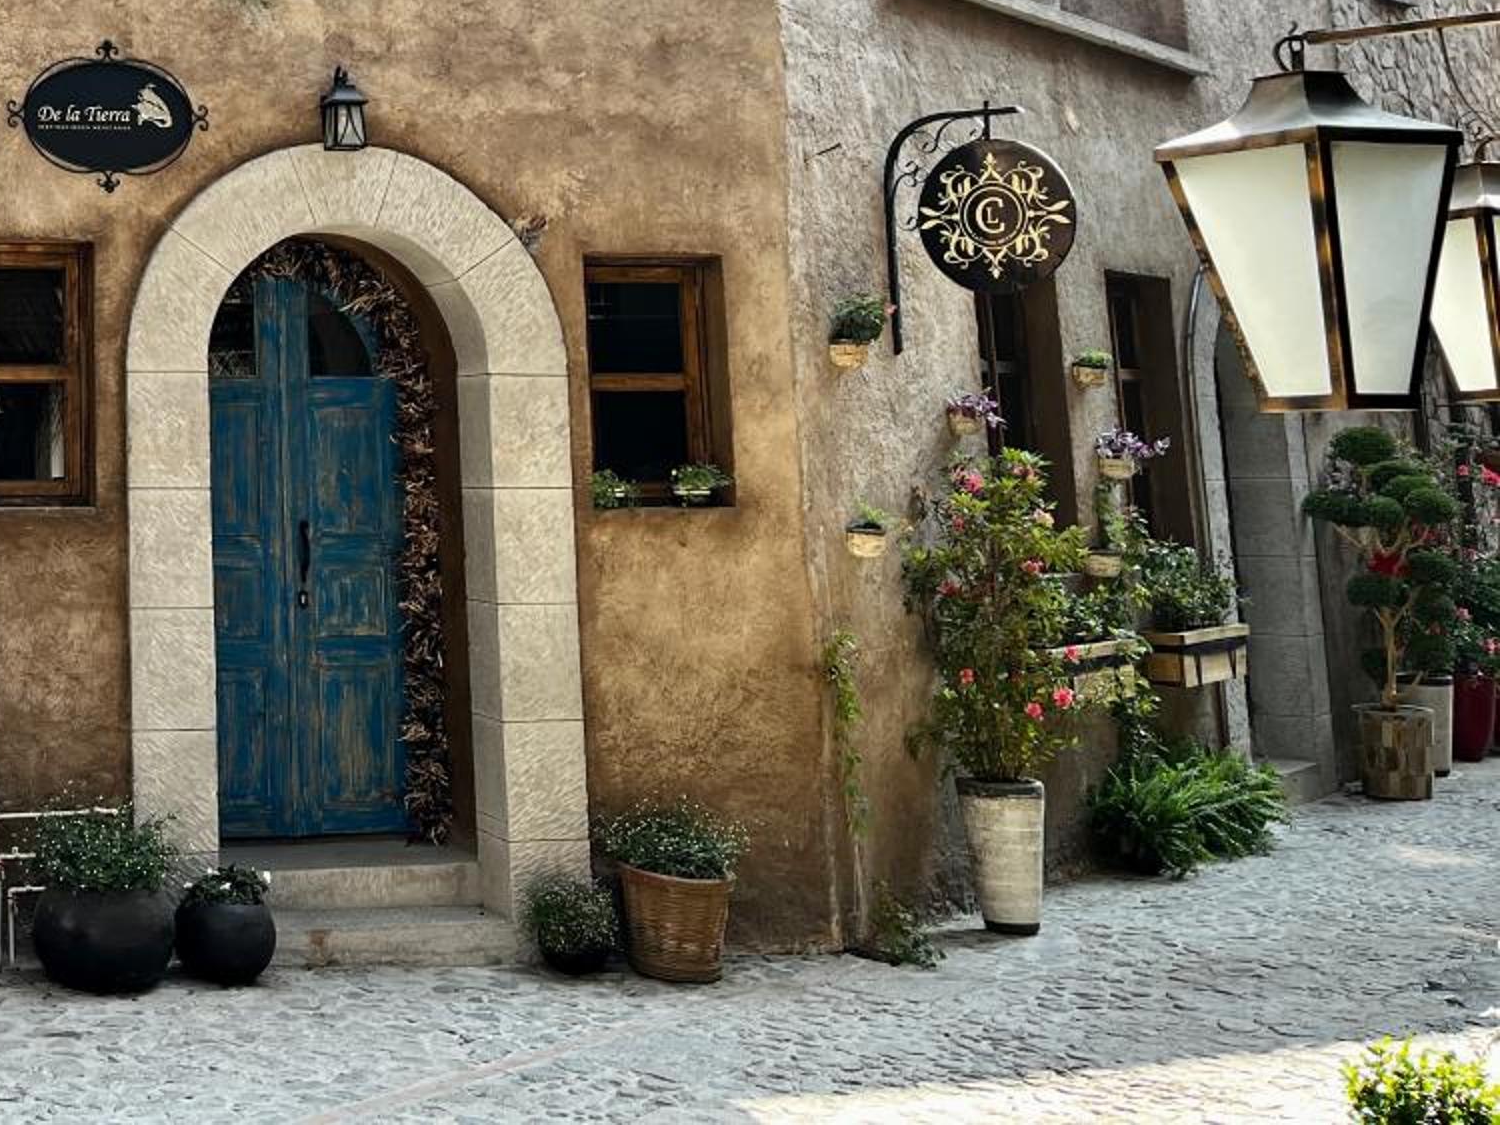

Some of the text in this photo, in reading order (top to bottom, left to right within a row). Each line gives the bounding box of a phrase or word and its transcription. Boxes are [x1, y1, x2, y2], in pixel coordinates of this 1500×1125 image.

[37, 104, 131, 122] De la Tierra
